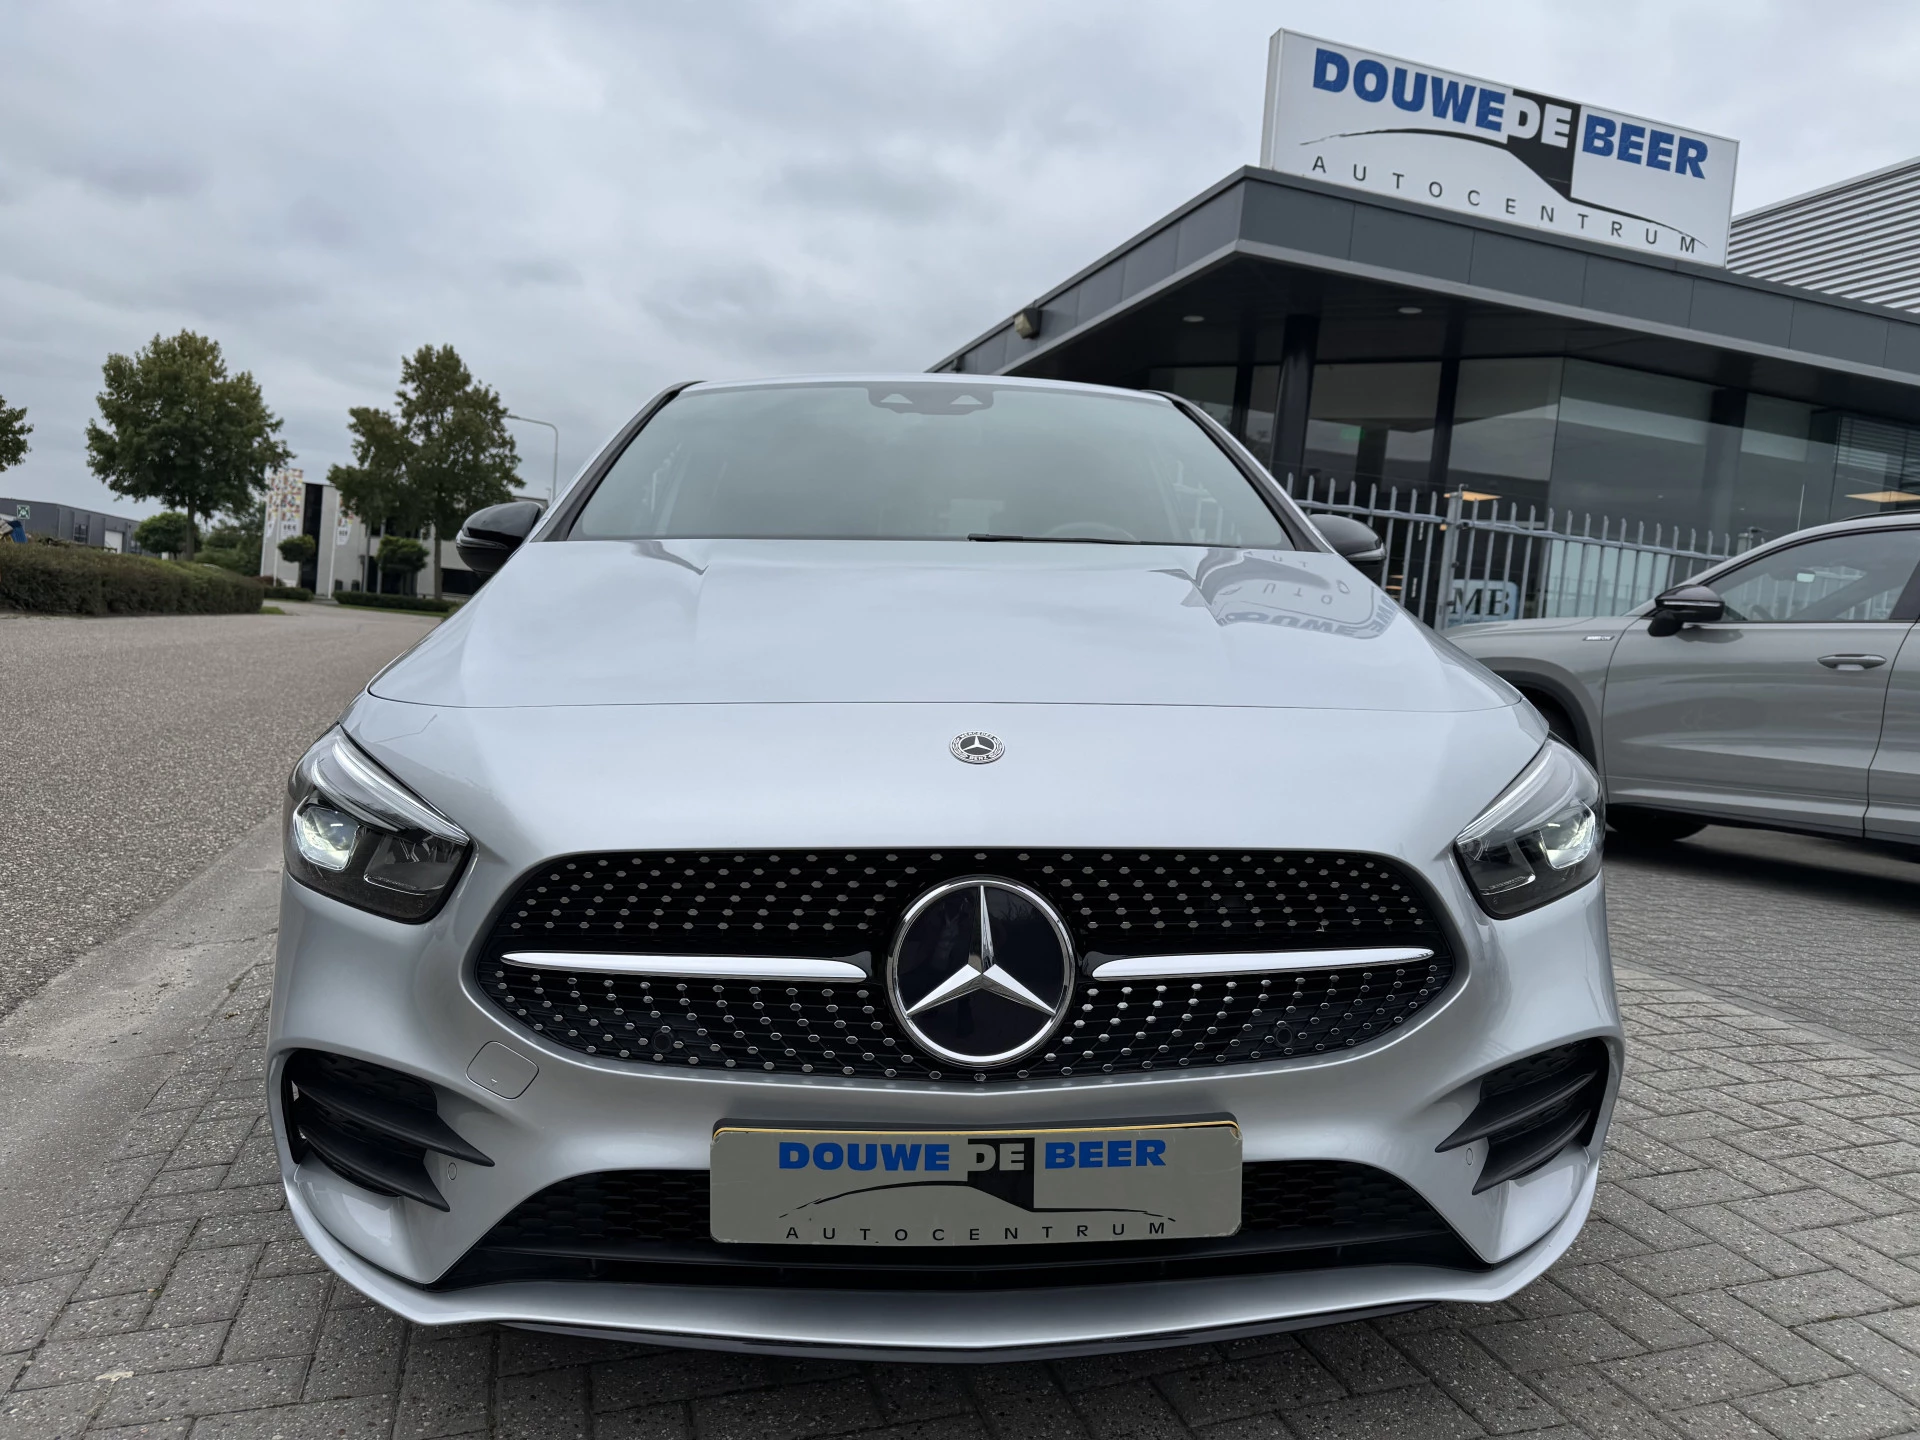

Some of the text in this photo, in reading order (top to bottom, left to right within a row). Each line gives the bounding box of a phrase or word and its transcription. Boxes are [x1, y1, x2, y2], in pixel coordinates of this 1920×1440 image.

[1312, 47, 1708, 179] DOUWE DE BEER
[1312, 155, 1697, 254] AUTOCENTRUM
[778, 1139, 1166, 1171] DOUWE DE BEER
[785, 1222, 1165, 1241] AUTOCENTRUM
